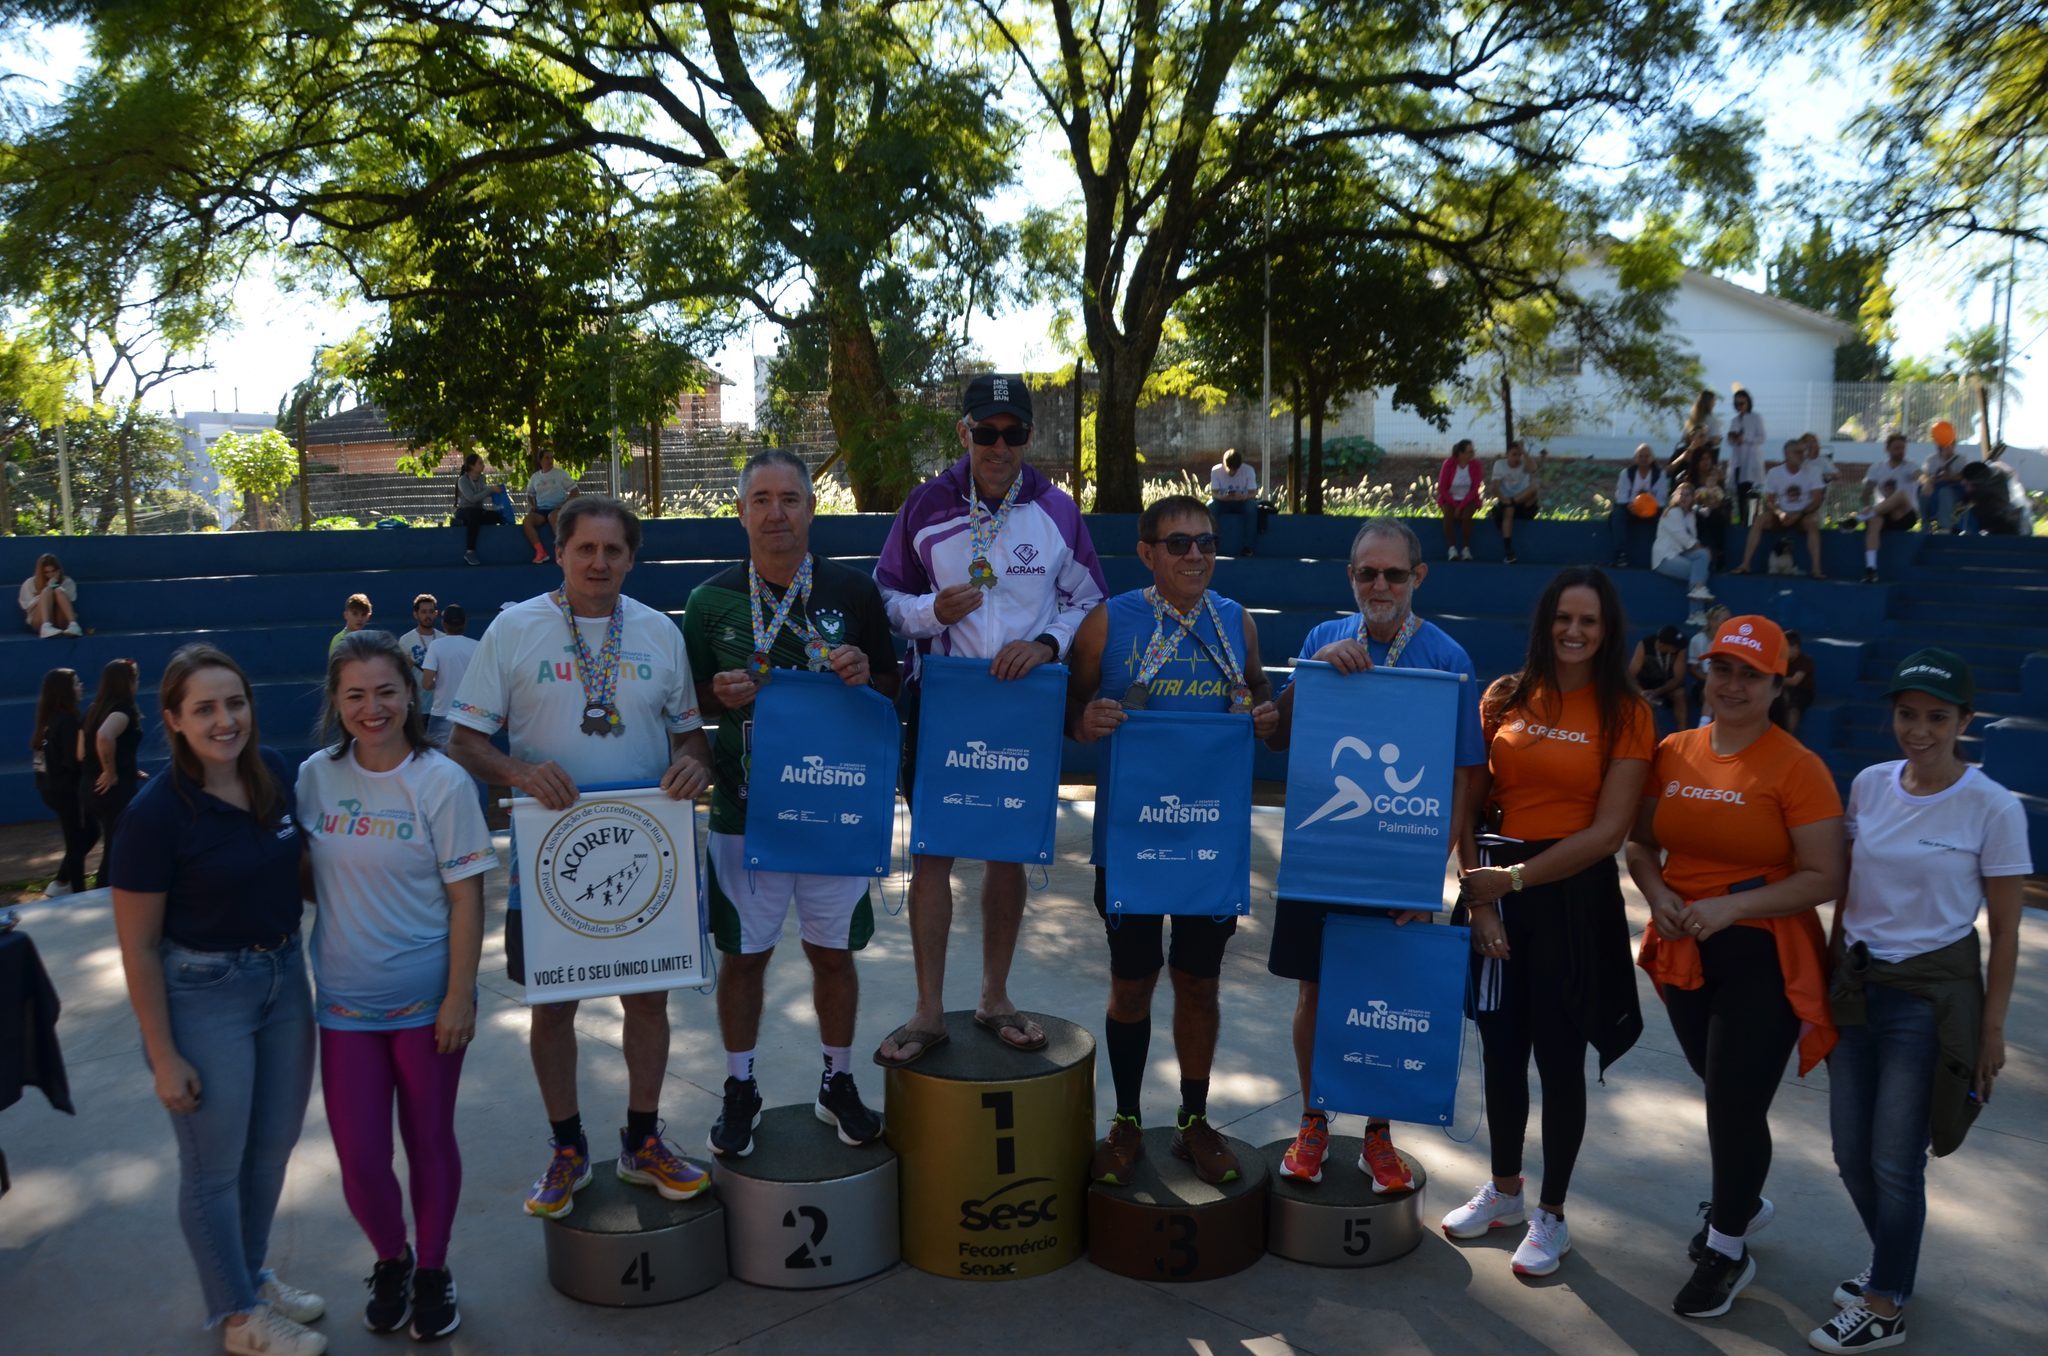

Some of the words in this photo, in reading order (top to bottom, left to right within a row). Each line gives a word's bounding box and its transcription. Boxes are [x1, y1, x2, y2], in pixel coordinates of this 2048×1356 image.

[1006, 566, 1046, 574] ACRAMS
[1721, 634, 1764, 652] CRESOL
[1527, 723, 1590, 744] CRESOL
[945, 750, 1029, 771] Autismo
[780, 765, 866, 787] Autismo
[1374, 795, 1440, 817] GCOR
[1681, 785, 1746, 805] CRESOL
[582, 808, 593, 818] de
[594, 805, 643, 821] Corredores
[642, 818, 653, 829] de
[651, 826, 664, 843] Rua
[1139, 805, 1220, 823] Autismo
[312, 812, 413, 840] Autismo
[1378, 821, 1439, 836] Palmitinho
[560, 826, 634, 882] ACORFW
[534, 966, 564, 986] VOCÊ
[568, 966, 575, 982] É
[578, 969, 586, 981] O
[589, 966, 611, 980] SEU
[614, 960, 648, 977] ÚNICO
[651, 955, 693, 973] LIMITE!
[1346, 1008, 1430, 1032] Autismo
[982, 1091, 1015, 1175] 1
[960, 1194, 1058, 1231] Sesc
[783, 1205, 832, 1269] 2
[959, 1236, 1058, 1257] Fecomércio
[1154, 1214, 1198, 1277] 3
[1343, 1218, 1371, 1256] 5
[621, 1252, 655, 1291] 4
[960, 1261, 1016, 1276] Senac
